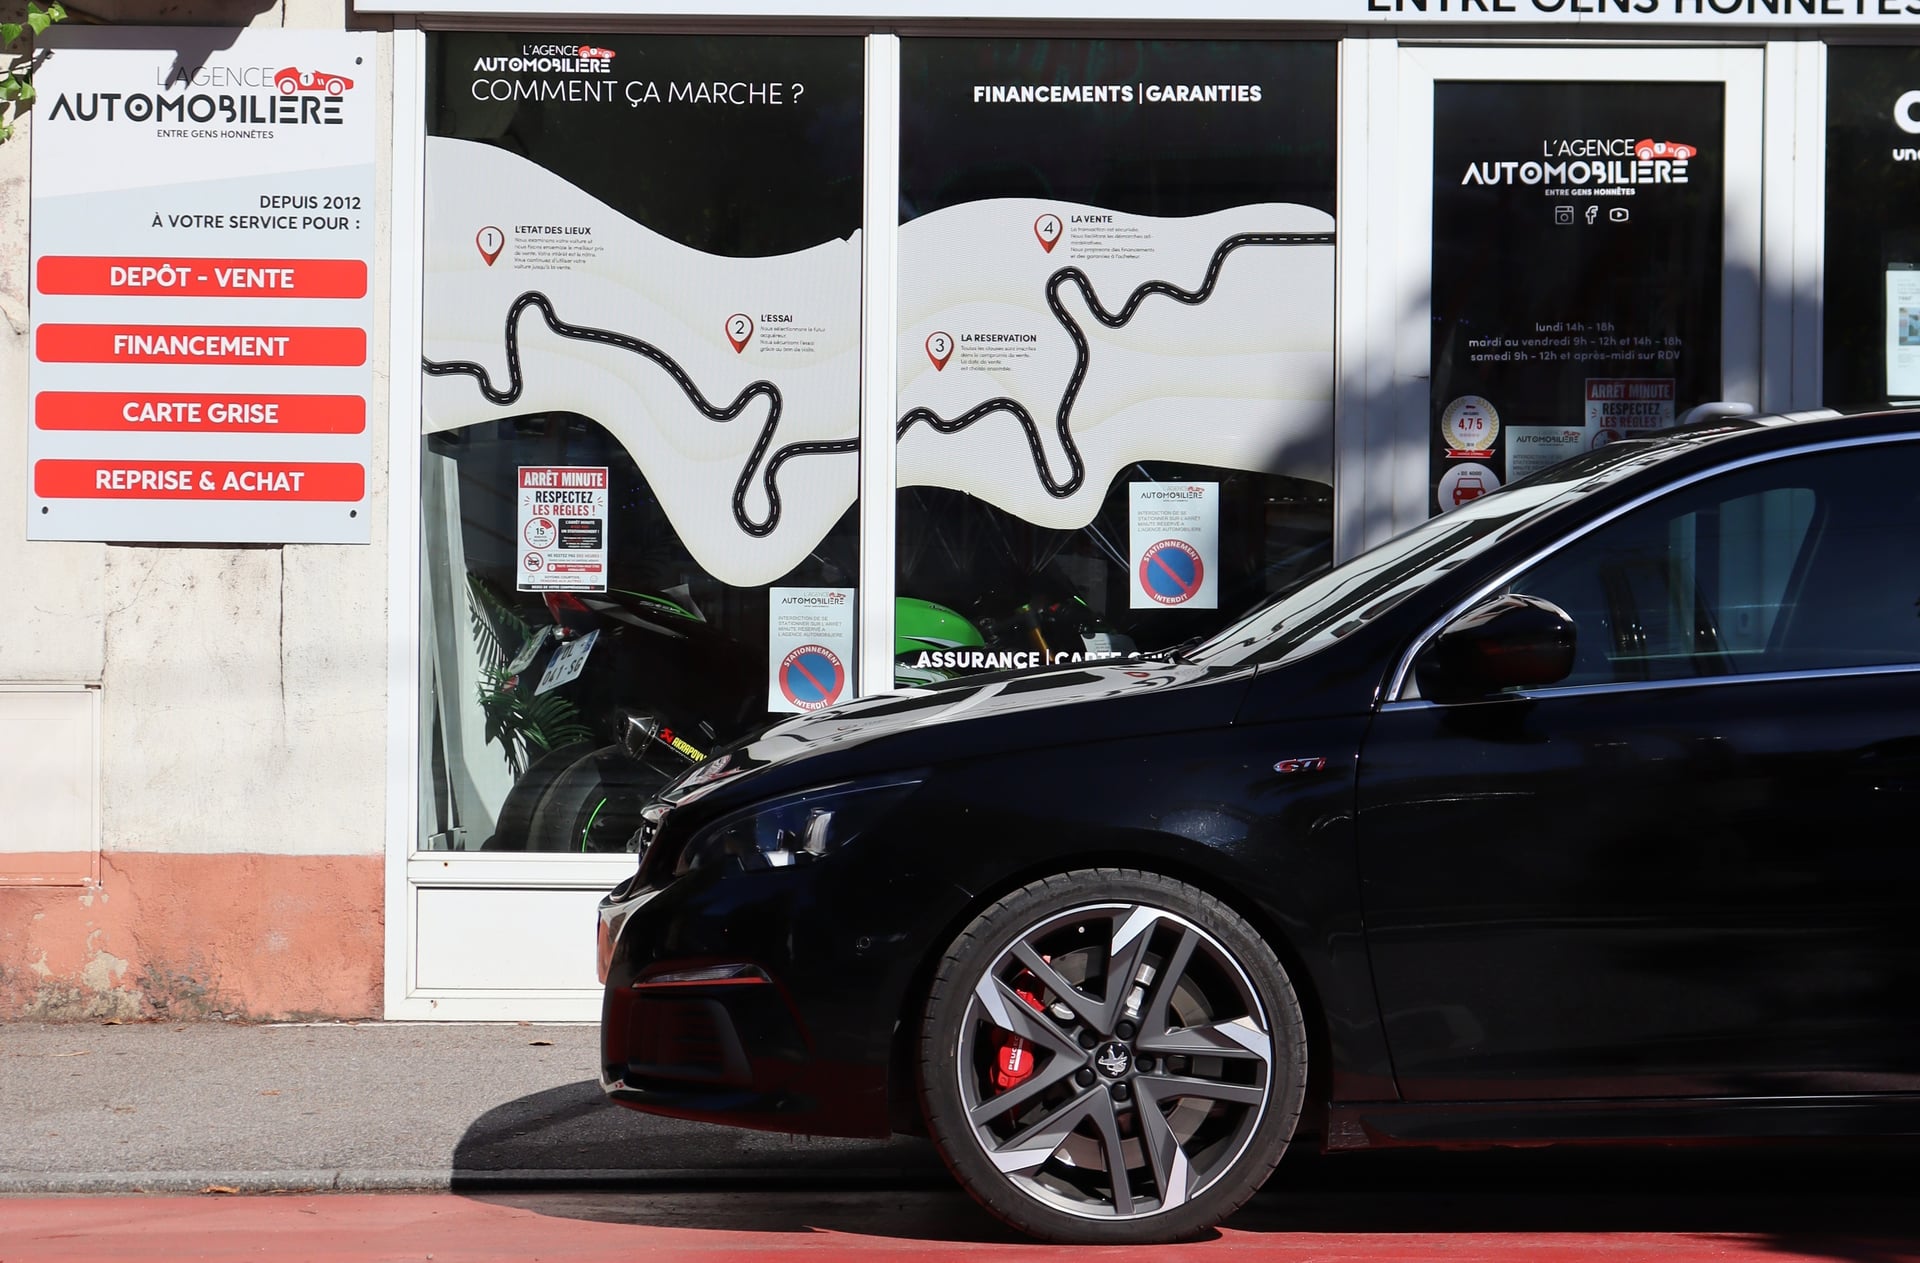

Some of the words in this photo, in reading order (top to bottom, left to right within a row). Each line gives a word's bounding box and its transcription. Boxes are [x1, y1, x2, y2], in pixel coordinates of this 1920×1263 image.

[523, 45, 578, 56] L'AGENCE
[157, 66, 274, 87] L'AGENCE
[471, 78, 618, 102] COMMENT
[625, 81, 660, 107] ÇA
[668, 82, 783, 105] MARCHE
[791, 83, 804, 105] ?
[973, 85, 1134, 102] FINANCEMENTS
[1145, 84, 1262, 102] GARANTIES
[157, 129, 189, 138] ENTRE
[191, 129, 218, 138] GENS
[220, 129, 274, 139] HONNÊTES
[1543, 139, 1635, 157] L'AGENCE
[1545, 188, 1570, 196] ENTRE
[1571, 188, 1592, 196] GENS
[1593, 186, 1636, 196] HONNÊTES
[260, 195, 318, 209] DEPUIS
[323, 196, 361, 209] 2012
[152, 211, 163, 227] À
[168, 214, 224, 228] VOTRE
[229, 215, 298, 229] SERVICE
[302, 216, 349, 230] POUR
[356, 220, 360, 229] :
[1071, 215, 1082, 223] LA
[1083, 215, 1113, 223] VENTE
[515, 225, 543, 234] L'ETAT
[545, 226, 563, 235] DES
[564, 227, 591, 235] LIEUX
[1044, 221, 1054, 234] 4
[487, 233, 492, 247] 1
[110, 263, 191, 287] DEPÔT
[214, 267, 294, 289] VENTE
[761, 314, 793, 323] L'ESSAI
[735, 320, 744, 334] 2
[1535, 322, 1563, 332] lundi
[1566, 323, 1584, 332] 14h
[1597, 322, 1615, 332] 18h
[935, 338, 945, 352] 3
[961, 334, 972, 342] LA
[974, 334, 1037, 342] RESERVATION
[1469, 337, 1502, 347] mardi
[1504, 339, 1518, 347] au
[1522, 336, 1570, 346] vendredi
[1574, 337, 1587, 346] 9h
[1600, 336, 1616, 346] 12h
[1634, 336, 1651, 346] 14h
[1664, 336, 1682, 346] 18h
[113, 334, 289, 357] FINANCEMENT
[1470, 352, 1511, 361] samedi
[1514, 352, 1528, 360] 9h
[1540, 352, 1557, 360] 12h
[1560, 352, 1570, 360] et
[1574, 351, 1635, 362] après-midi
[1638, 352, 1654, 360] sur
[1657, 351, 1680, 360] RDV
[1592, 382, 1626, 398] ARRÊT
[1628, 384, 1670, 398] MINUTE
[122, 402, 201, 423] CARTE
[207, 403, 279, 424] GRISE
[1602, 403, 1660, 415] RESPECTEZ
[1600, 416, 1616, 428] LES
[96, 469, 192, 491] REPRISE
[199, 471, 215, 491] &
[222, 471, 304, 493] ACHAT
[524, 469, 559, 486] ARRÊT
[561, 472, 603, 487] MINUTE
[535, 491, 593, 503] RESPECTEZ
[533, 504, 549, 515] LES
[1143, 541, 1199, 562] STATIONNEMENT
[1154, 593, 1188, 603] INTERDIT
[784, 645, 840, 667] STATIONNEMENT
[917, 651, 1040, 669] ASSURANCE
[794, 698, 828, 710] INTERDIT
